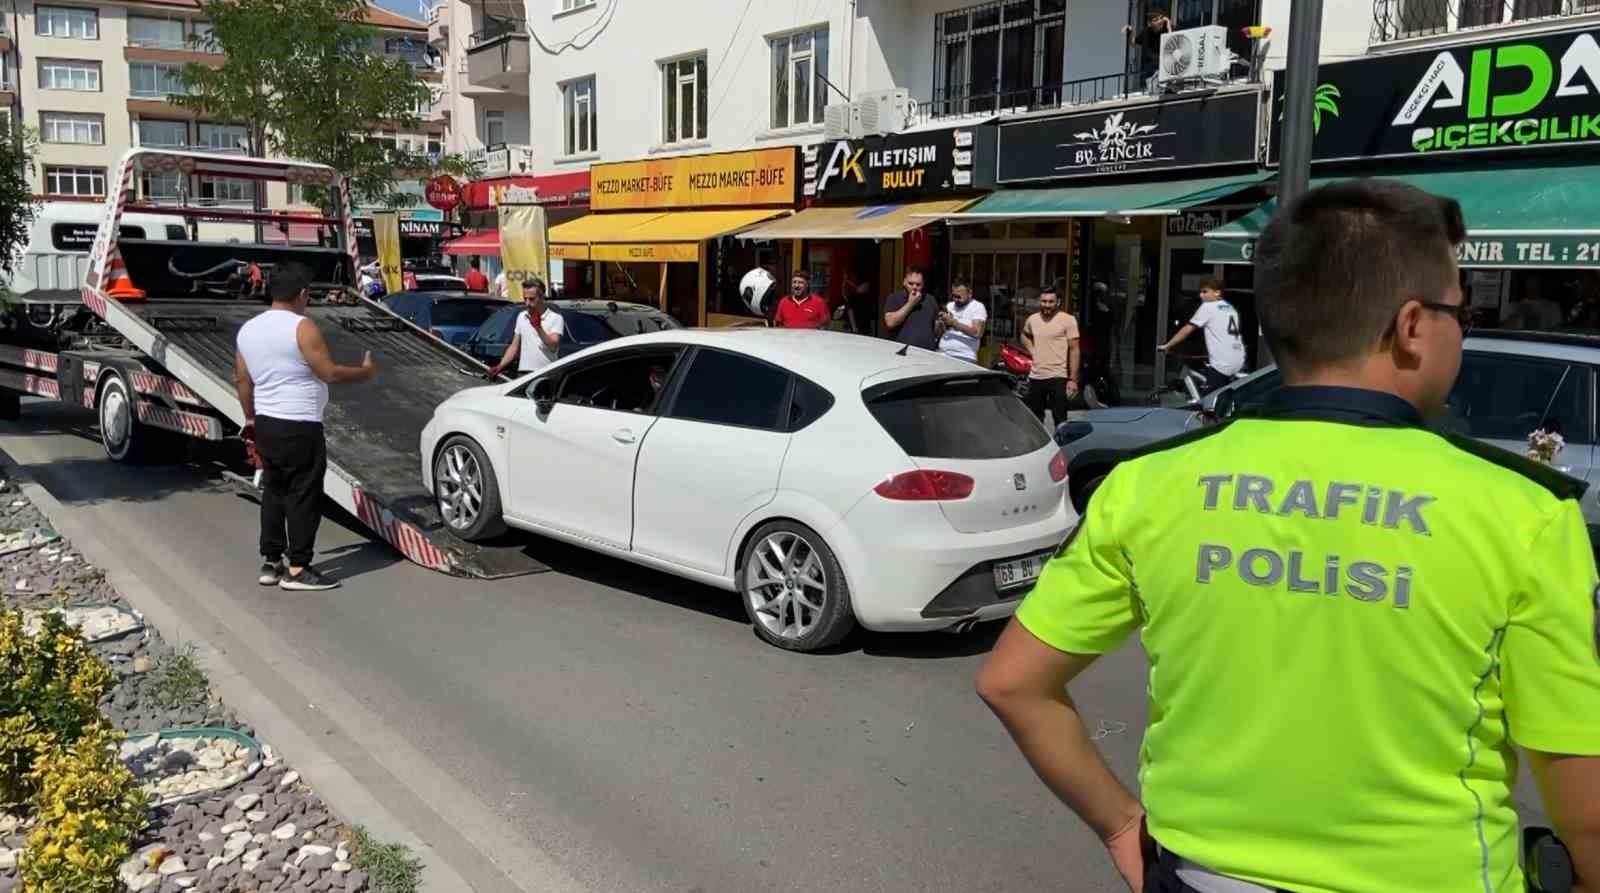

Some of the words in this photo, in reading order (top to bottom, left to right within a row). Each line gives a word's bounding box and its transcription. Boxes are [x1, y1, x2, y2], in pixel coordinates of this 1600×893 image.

[689, 172, 718, 191] MEZZO
[719, 164, 785, 188] MARKET-BÜFE
[817, 140, 867, 191] AK
[597, 180, 620, 194] MEZZO
[620, 171, 673, 193] MARKET-BÜFE
[882, 168, 925, 189] BULUT
[1517, 242, 1555, 261] TEL
[1227, 315, 1241, 341] 4
